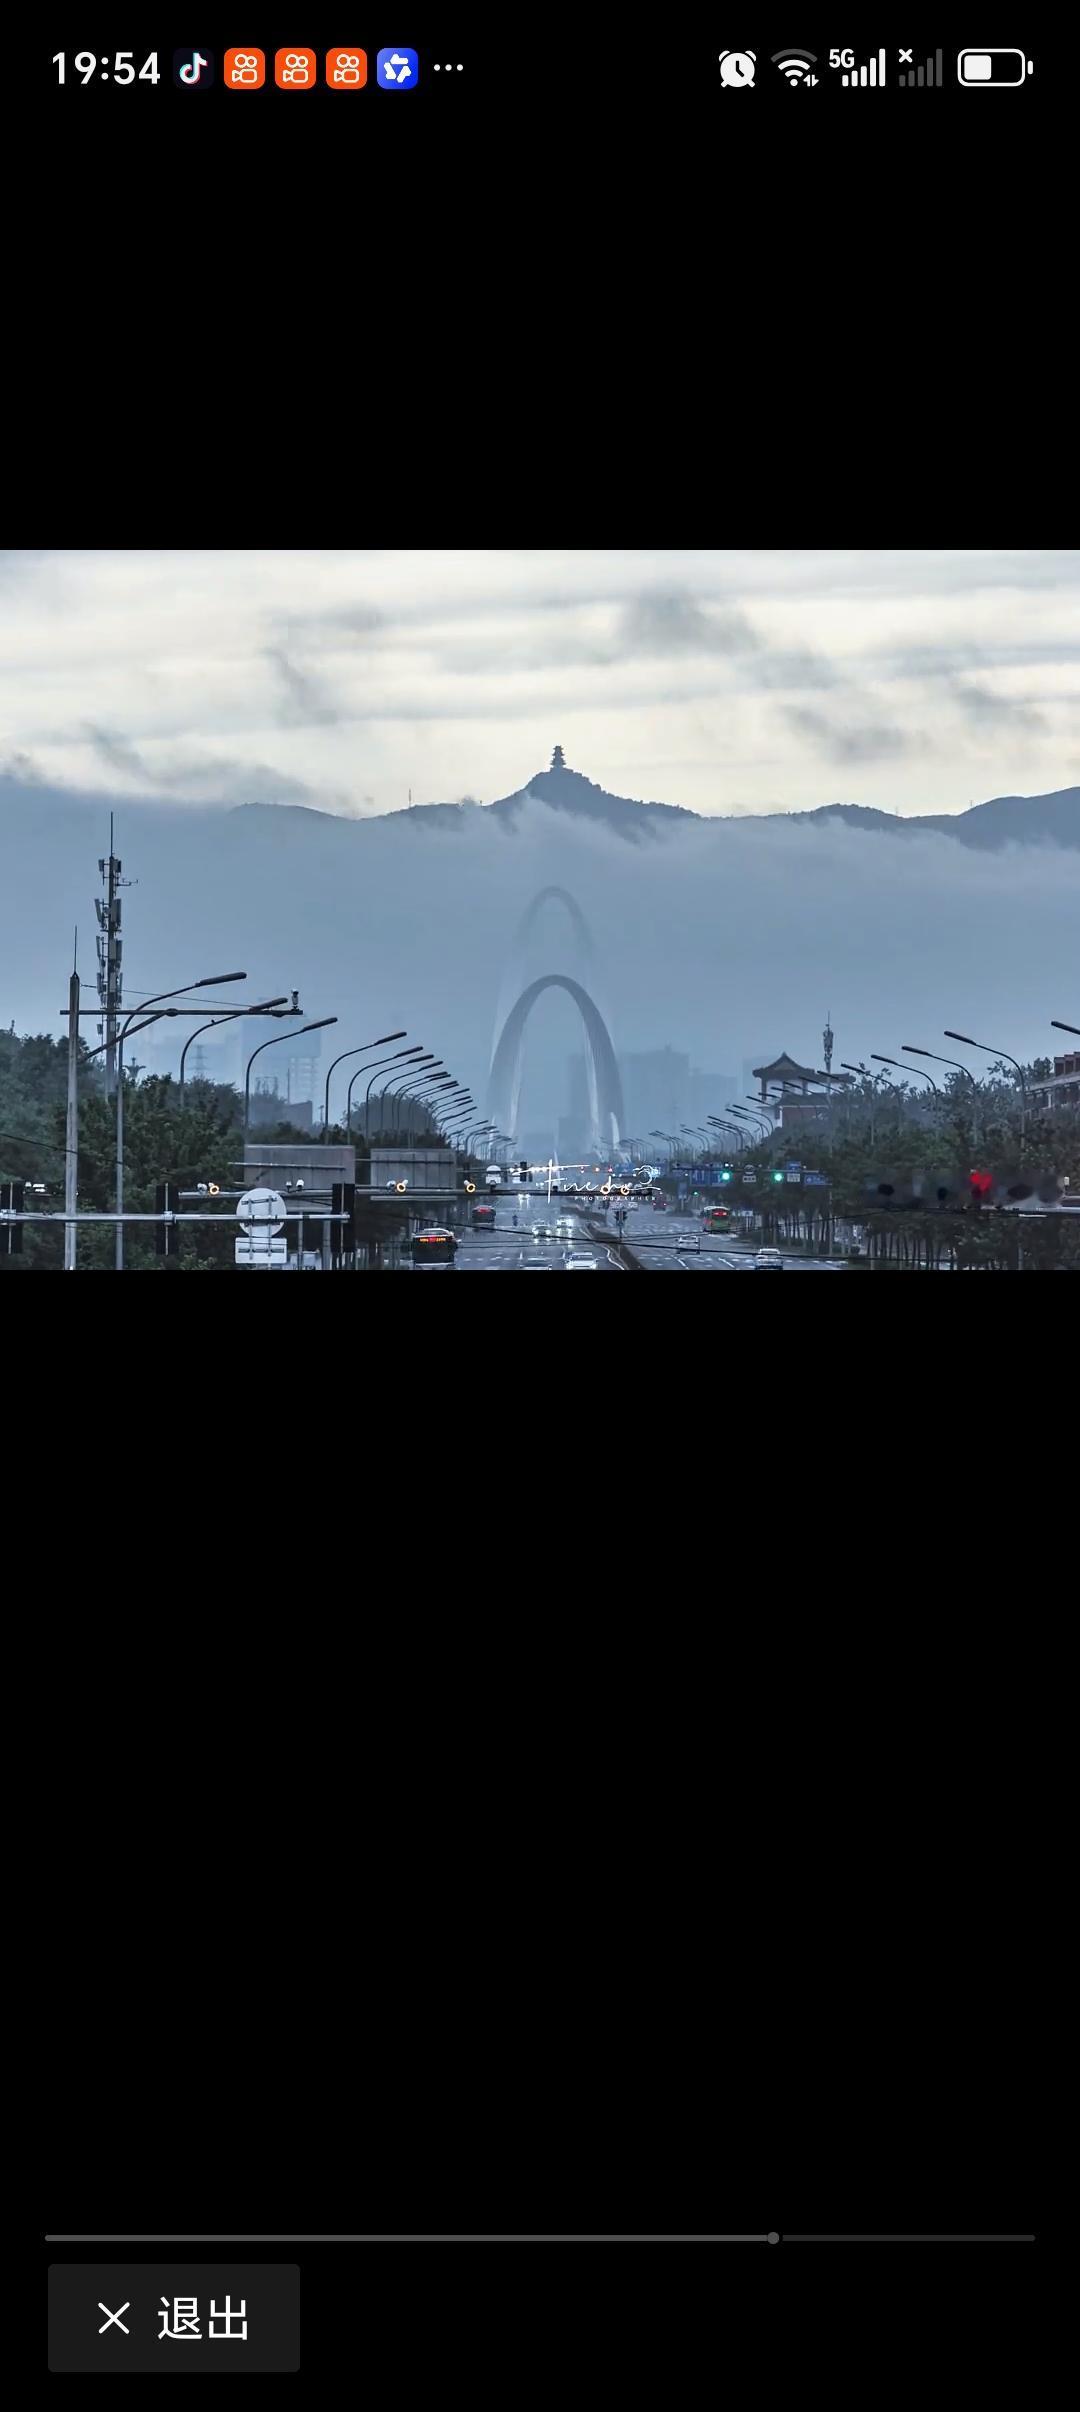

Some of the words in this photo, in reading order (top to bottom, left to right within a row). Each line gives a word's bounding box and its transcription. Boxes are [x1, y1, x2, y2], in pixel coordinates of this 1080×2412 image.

[53, 52, 160, 84] 19:54
[829, 49, 855, 68] 5G
[157, 2295, 249, 2341] 退出
